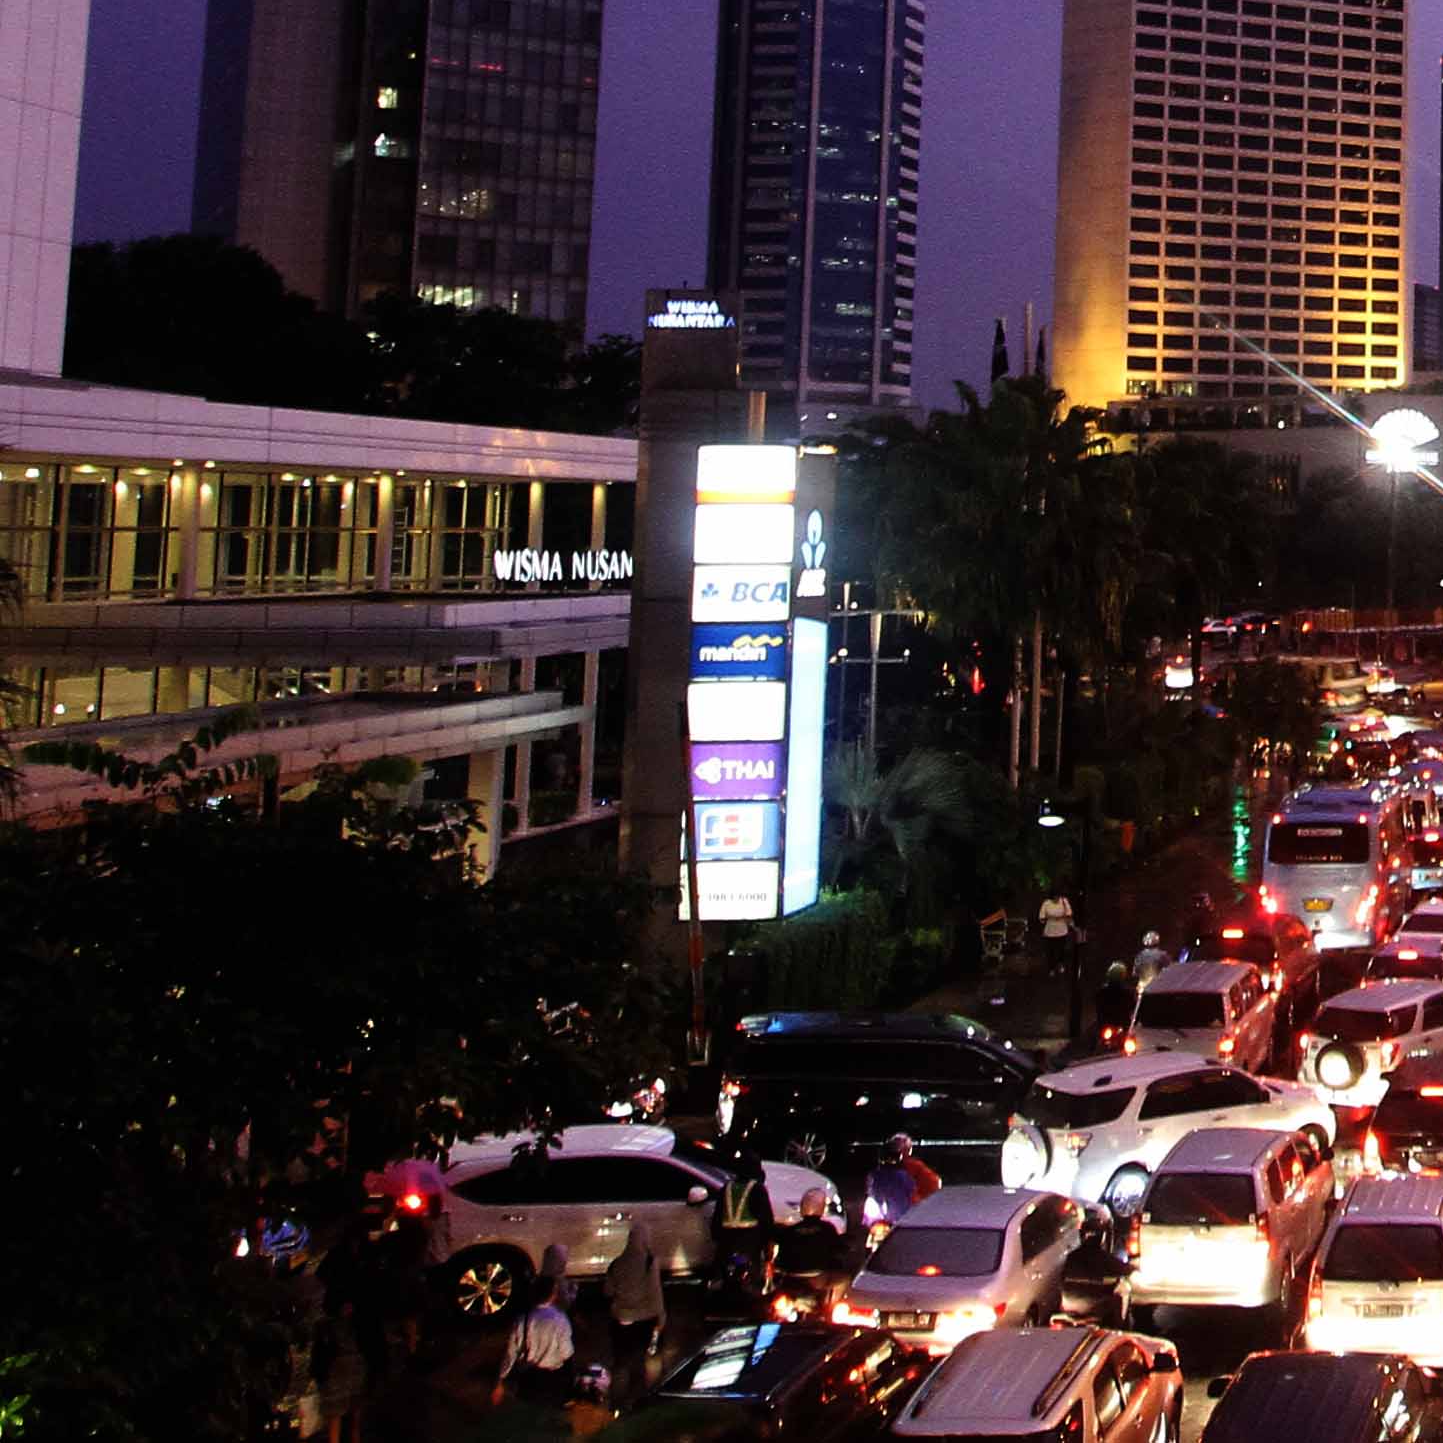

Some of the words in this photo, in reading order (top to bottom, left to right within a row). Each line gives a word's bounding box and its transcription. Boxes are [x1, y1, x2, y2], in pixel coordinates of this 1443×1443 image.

[666, 300, 720, 314] WISMA
[647, 313, 736, 329] NUSANTARA
[493, 547, 563, 583] WISMA
[730, 581, 789, 604] BCA
[721, 760, 776, 781] THAI
